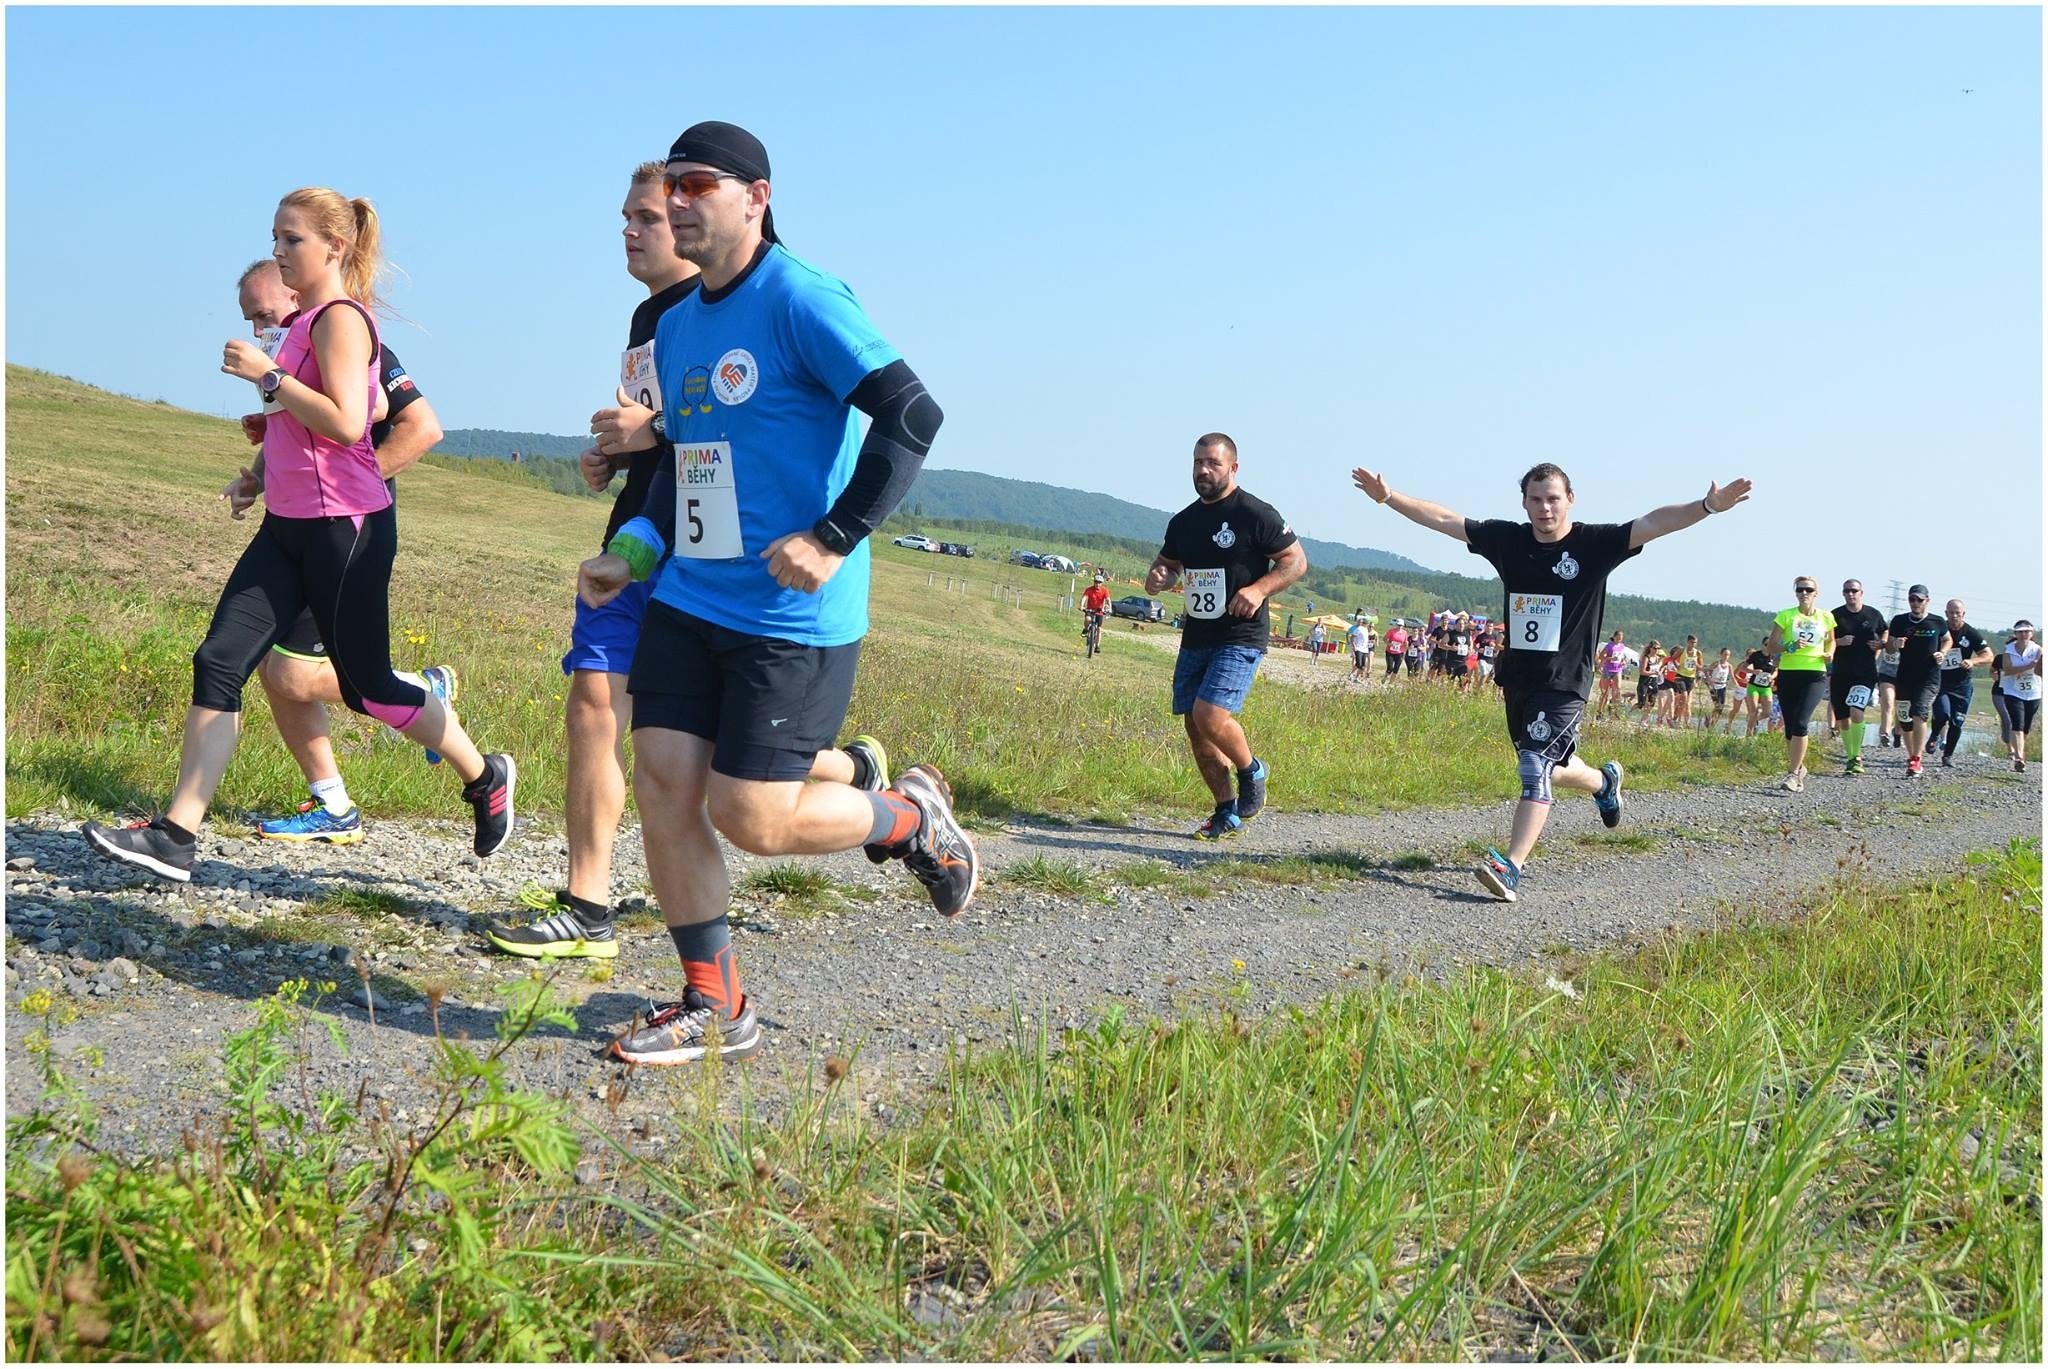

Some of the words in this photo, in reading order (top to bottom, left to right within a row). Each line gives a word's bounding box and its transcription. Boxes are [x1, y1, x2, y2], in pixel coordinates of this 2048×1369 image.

[682, 448, 722, 465] PRIMA
[687, 464, 716, 484] BĚHY
[687, 499, 704, 544] 5
[1194, 571, 1221, 580] PRIMA
[1198, 578, 1217, 587] BĚHY
[1191, 592, 1216, 613] 28
[1526, 597, 1556, 606] PRIMA
[1530, 605, 1552, 614] BĚHY
[1524, 620, 1539, 642] 8
[1946, 657, 1958, 666] 16
[2019, 681, 2032, 691] 35
[1847, 694, 1865, 705] 201
